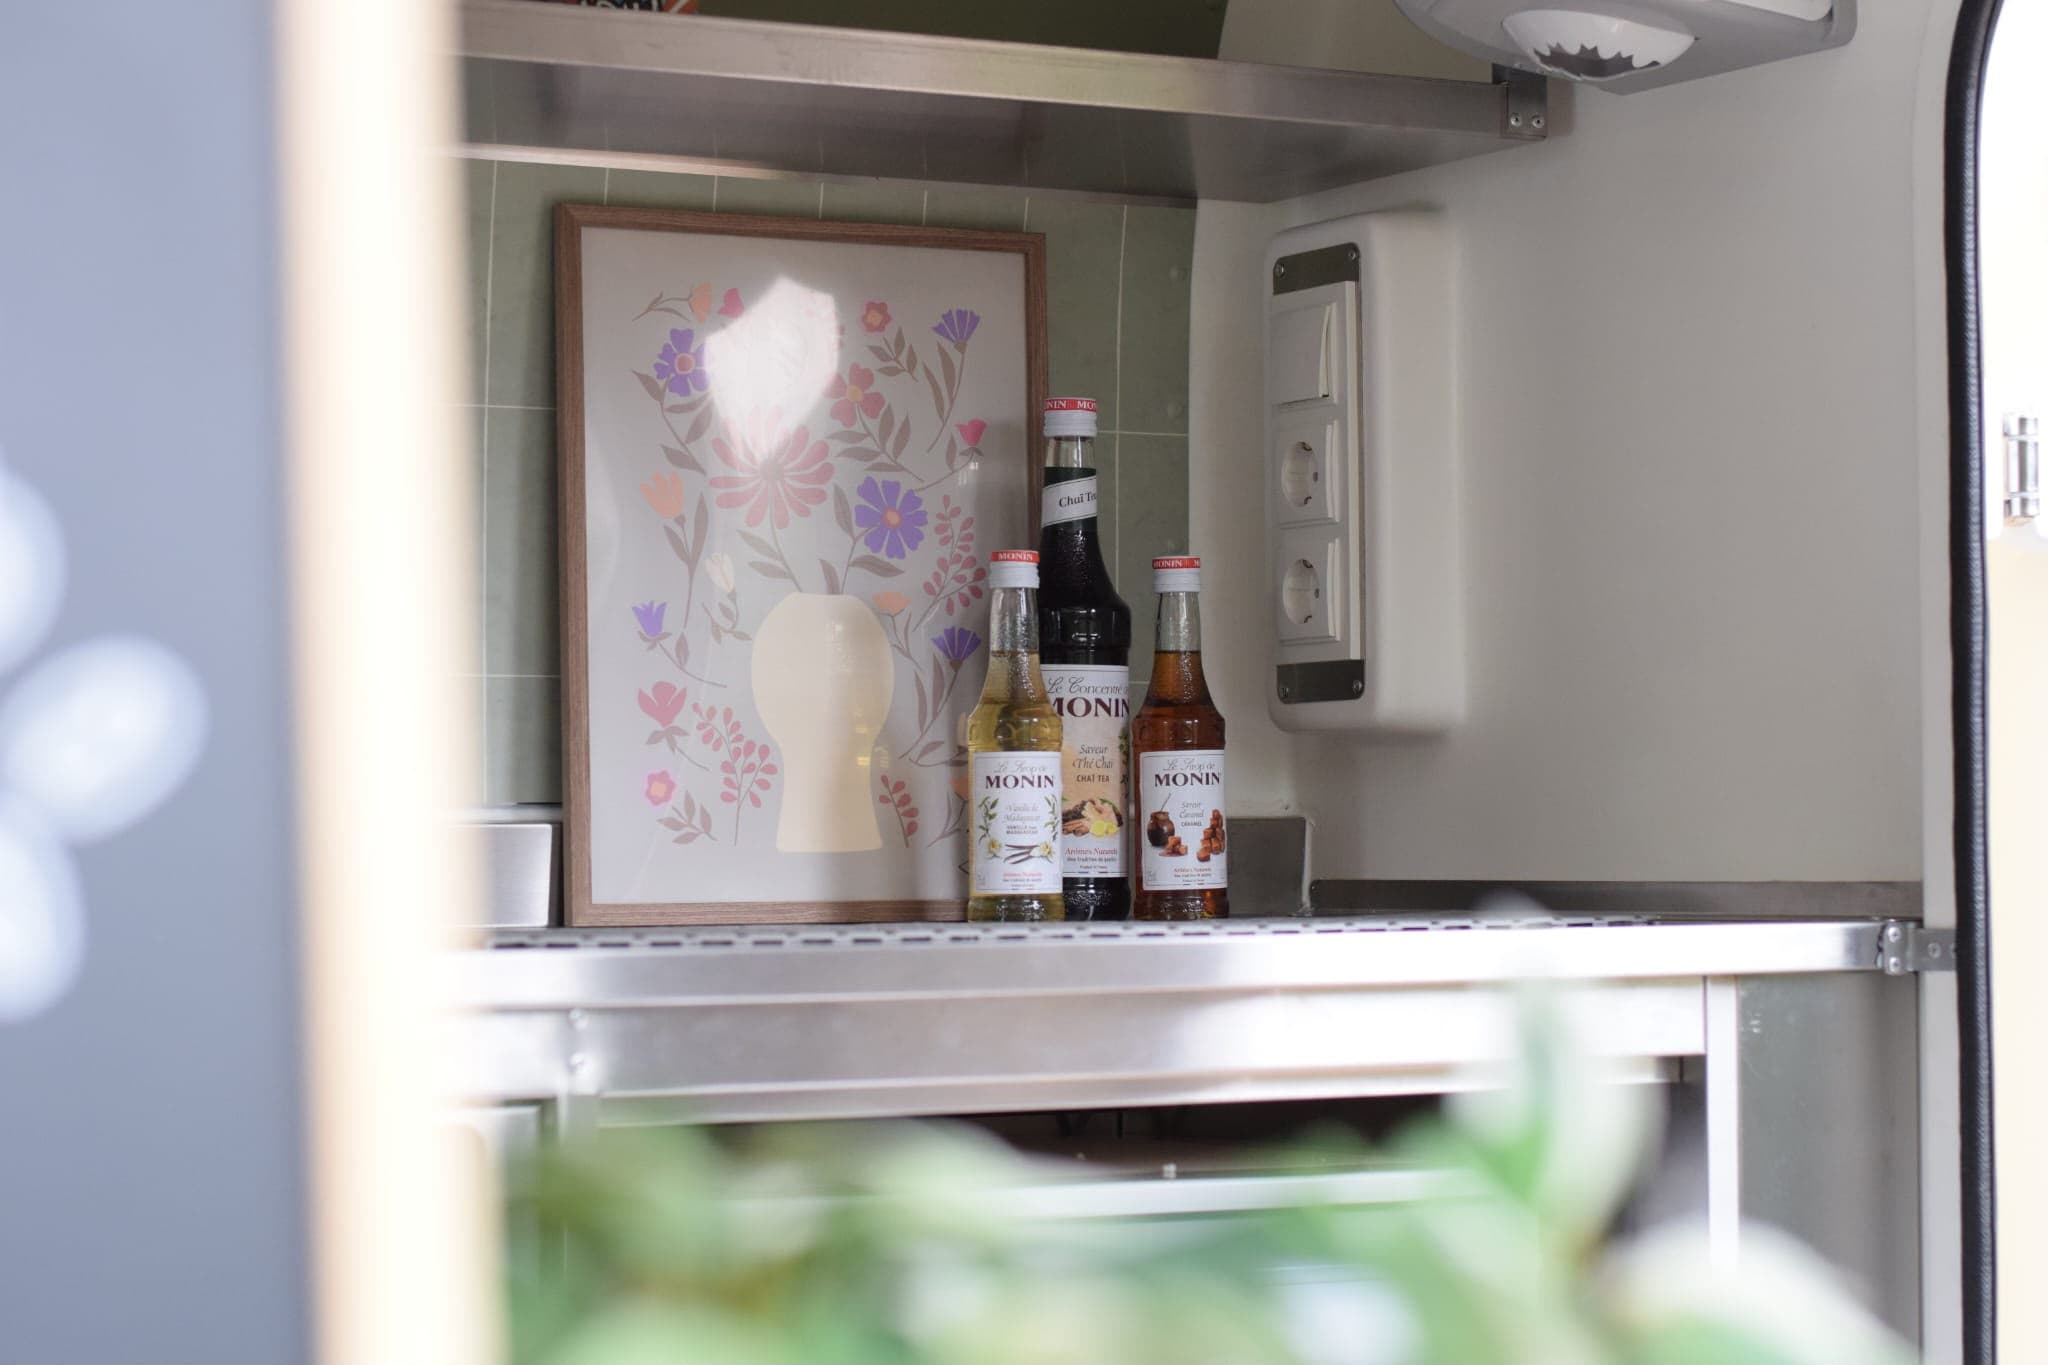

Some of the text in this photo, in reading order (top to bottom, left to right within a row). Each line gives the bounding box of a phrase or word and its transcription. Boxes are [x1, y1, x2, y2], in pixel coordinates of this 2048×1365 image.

[998, 551, 1034, 561] MONIN
[1047, 676, 1064, 694] Le
[985, 774, 1055, 789] MONIN
[1154, 771, 1221, 788] MONIN
